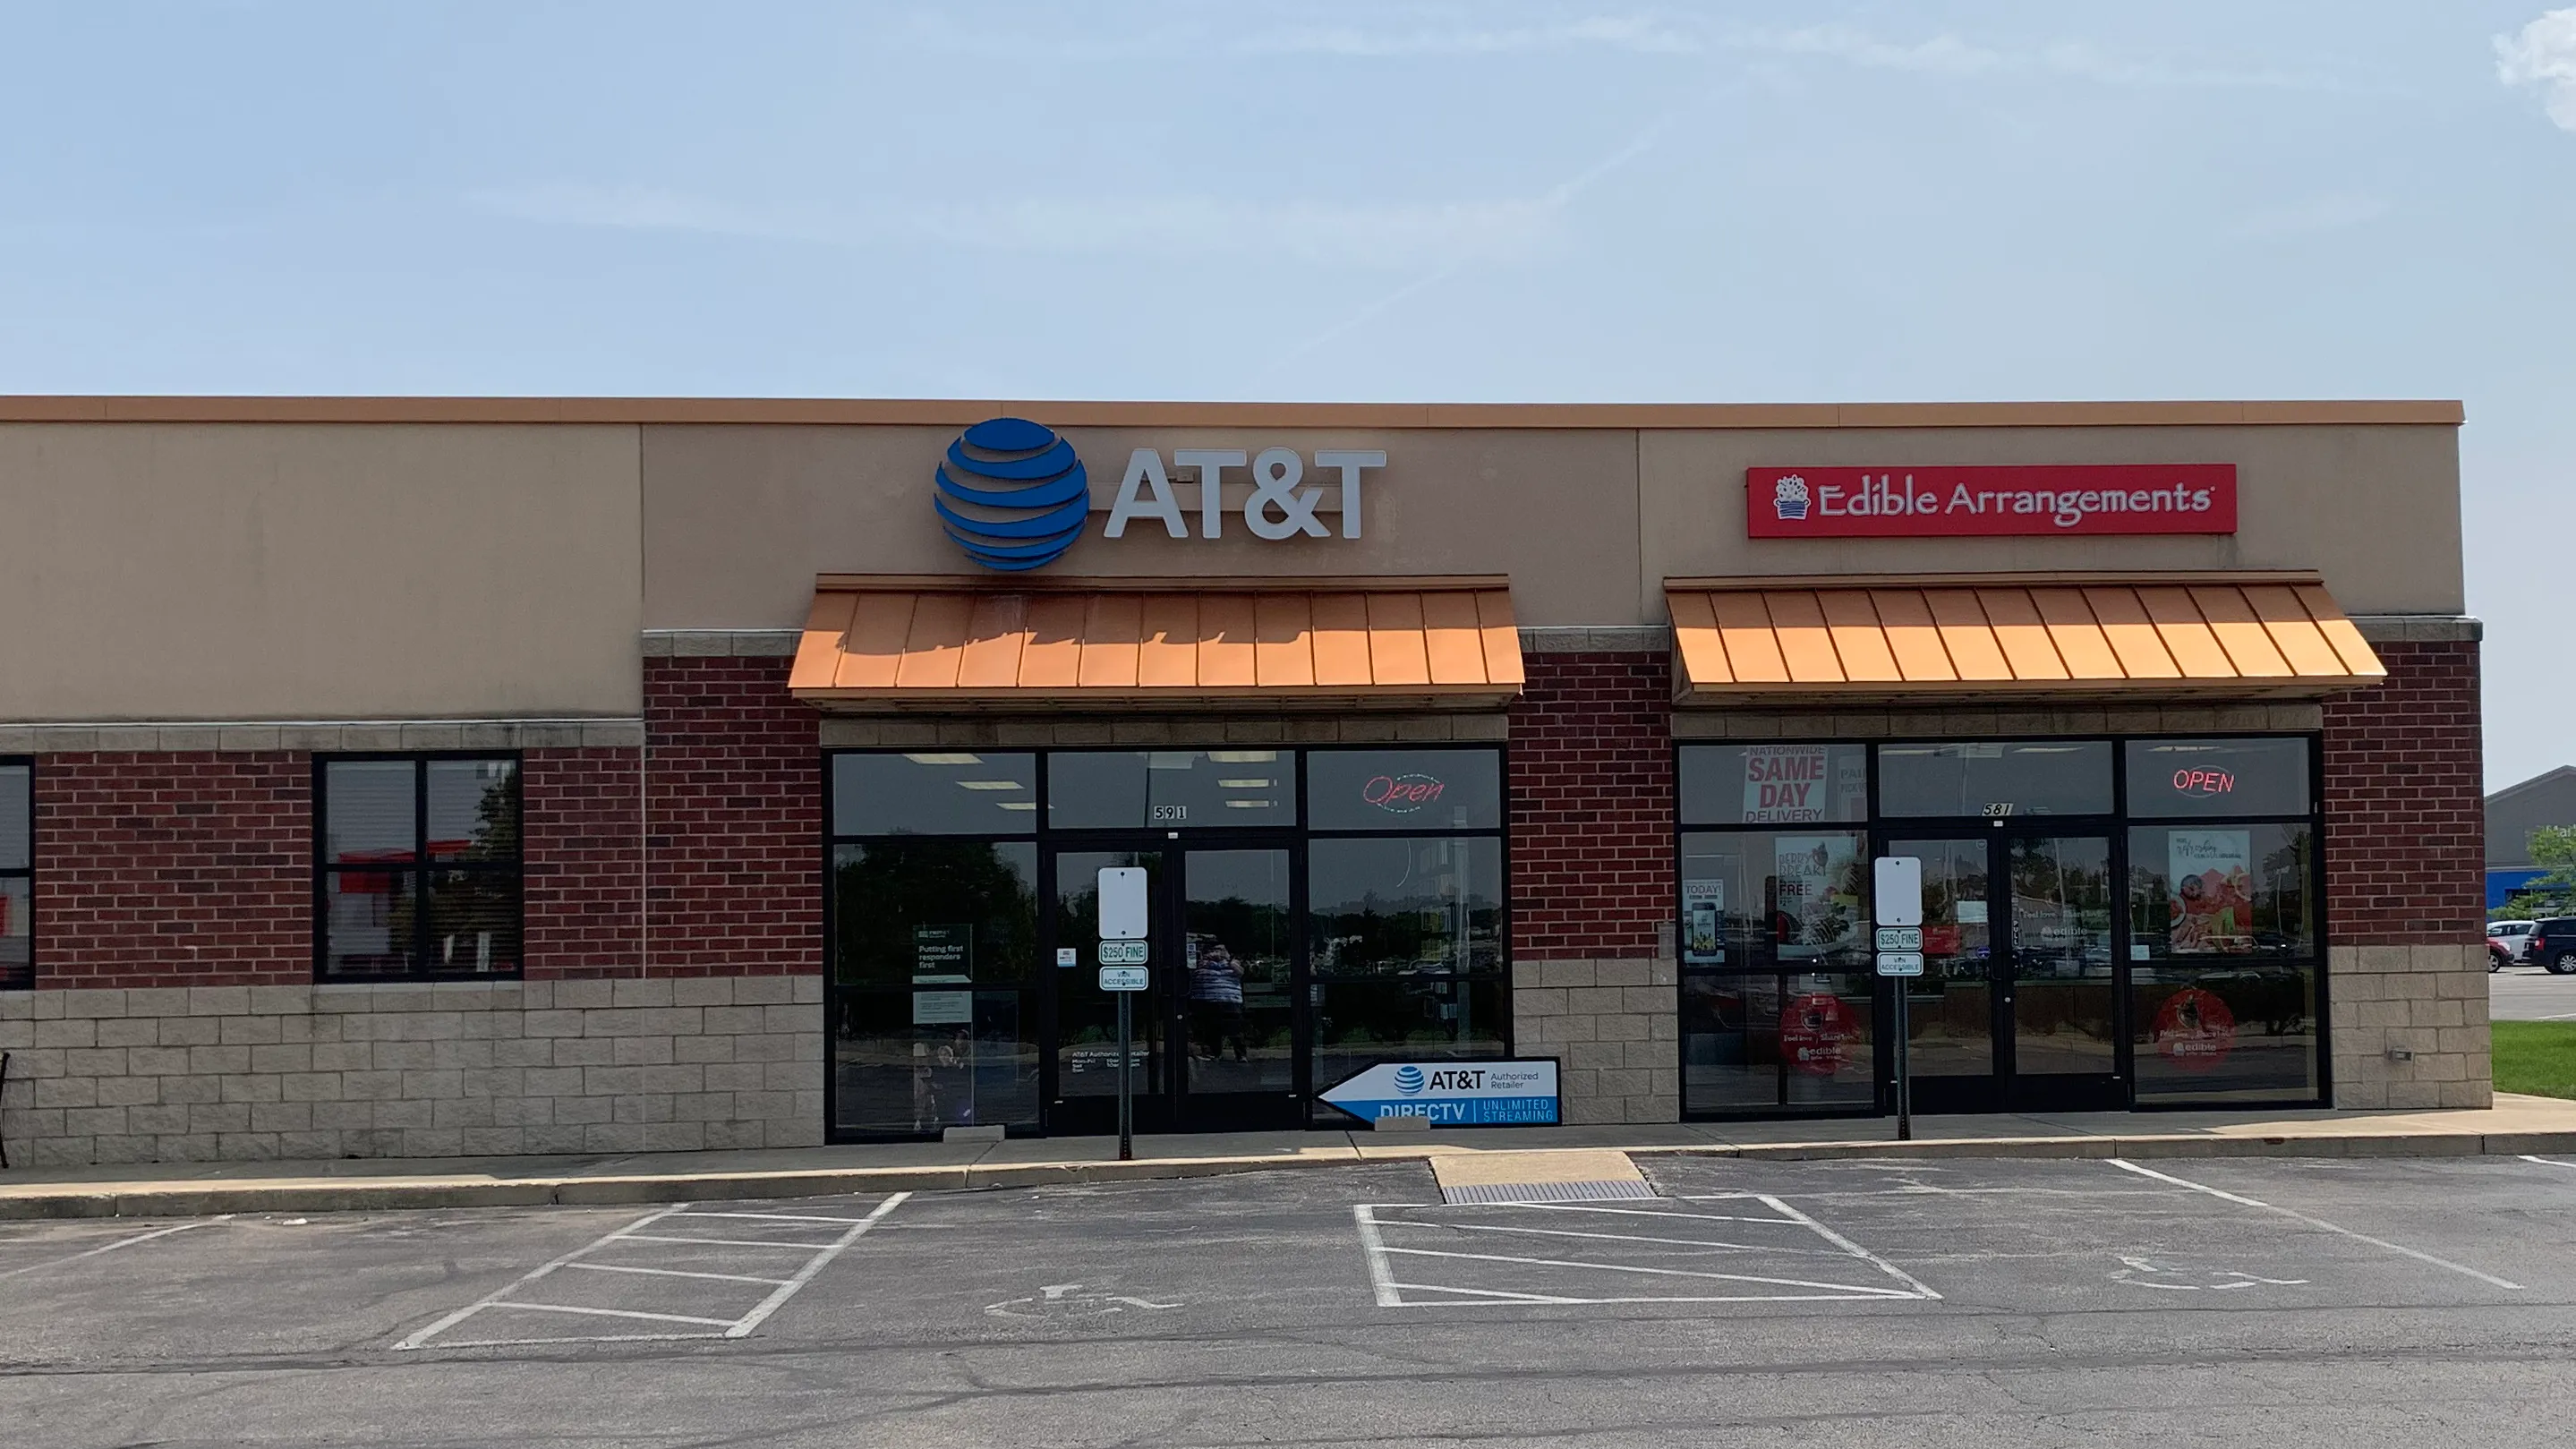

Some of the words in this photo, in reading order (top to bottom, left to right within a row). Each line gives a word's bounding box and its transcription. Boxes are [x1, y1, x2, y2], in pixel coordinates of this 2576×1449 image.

[1104, 447, 1386, 540] AT&T
[1818, 473, 1939, 516] Edible
[1945, 482, 2212, 527] Arrangements
[1750, 746, 1826, 755] NATIONWIDE
[1748, 755, 1825, 781] SAME
[2173, 770, 2235, 793] OPEN
[1363, 776, 1444, 804] Open
[1759, 783, 1811, 808] DAY
[1155, 806, 1185, 819] 591
[1745, 808, 1823, 823] DELIVERY
[1983, 805, 2009, 815] 581
[1686, 885, 1722, 894] TODAY!
[1779, 884, 1813, 896] FREE
[2053, 927, 2087, 935] edible
[1881, 933, 1899, 945] $250
[1901, 933, 1919, 944] FINE
[918, 945, 946, 954] Putting
[1104, 946, 1124, 958] $250
[1126, 946, 1144, 958] FINE
[918, 953, 961, 961] responders
[918, 961, 935, 969] first
[2185, 1043, 2217, 1051] edible
[1429, 1070, 1486, 1090] AT&T
[1491, 1072, 1539, 1080] Authorized
[1491, 1081, 1523, 1089] Retailer
[1483, 1099, 1548, 1111] UNLIMITED
[1380, 1103, 1466, 1121] DIRECTV
[1483, 1111, 1553, 1122] STREAMING
